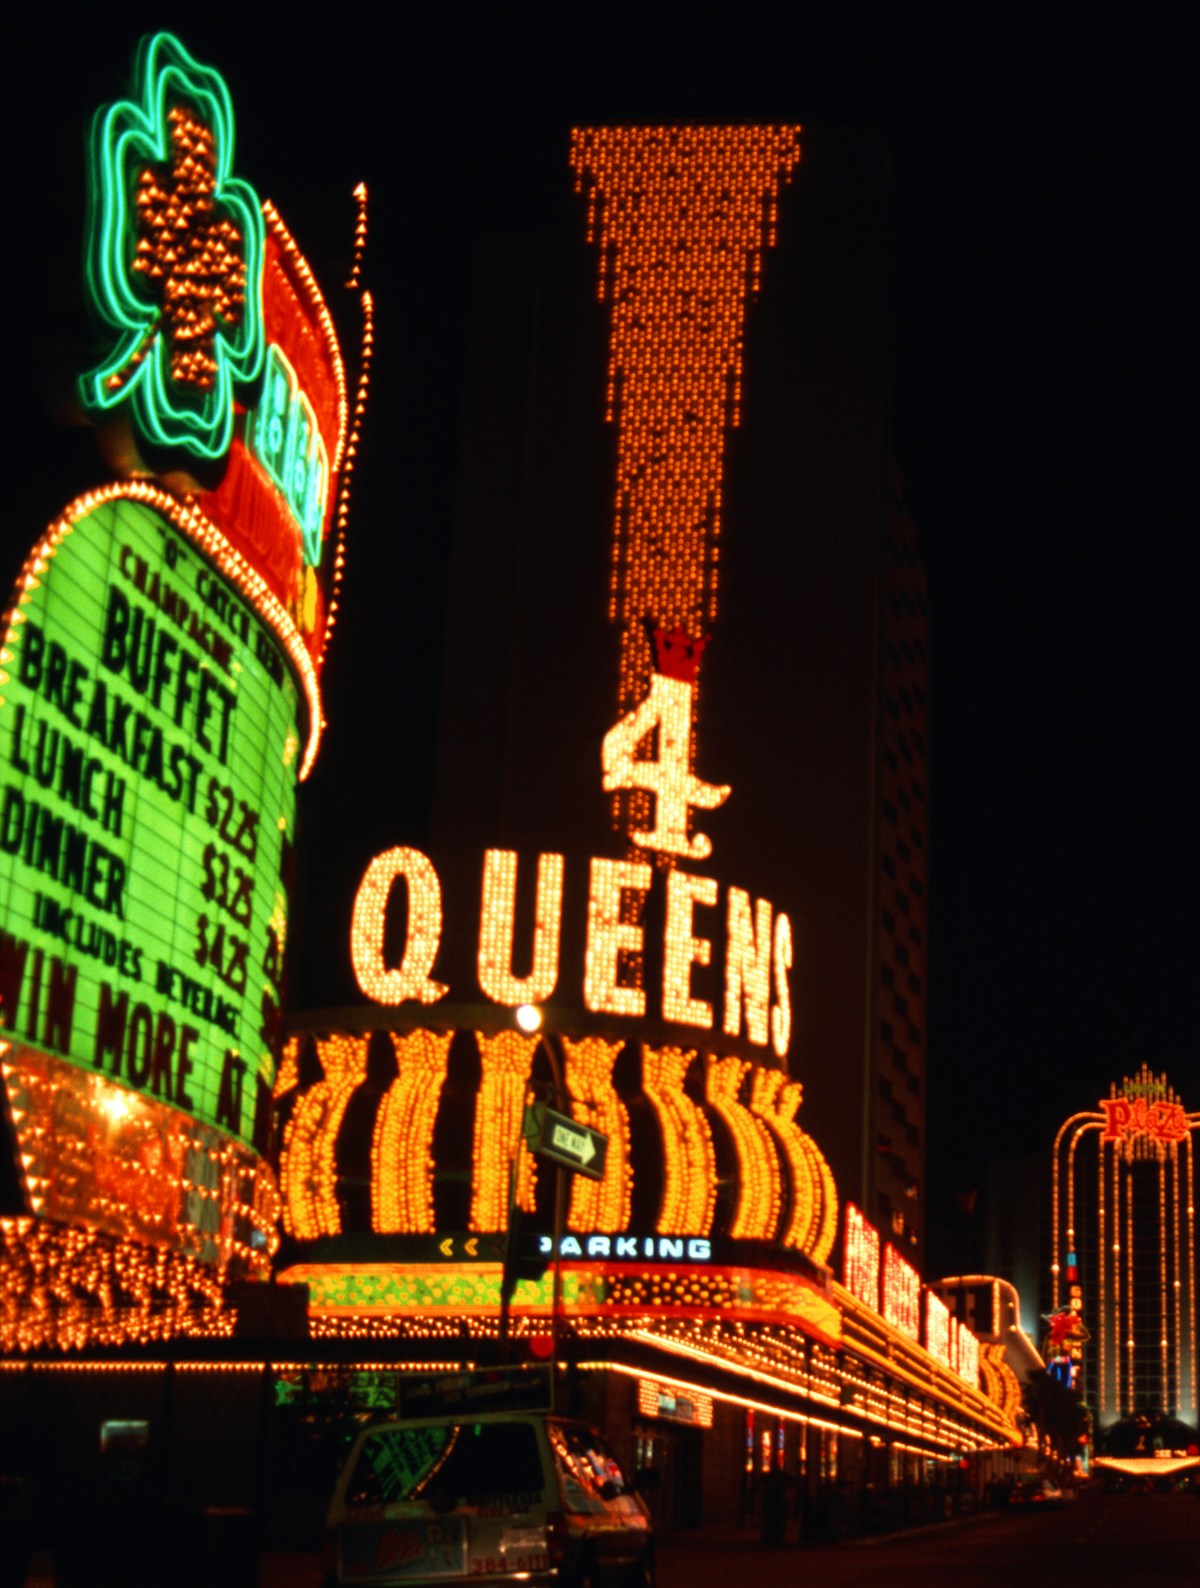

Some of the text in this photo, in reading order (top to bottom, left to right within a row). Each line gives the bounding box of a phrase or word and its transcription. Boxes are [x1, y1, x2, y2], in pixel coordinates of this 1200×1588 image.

[20, 622, 203, 815] BREAKFAST
[99, 583, 239, 767] BUFFET
[10, 704, 126, 839] LUNCH
[601, 672, 733, 860] 4
[2, 785, 127, 921] DINNER
[34, 892, 143, 983] INCLUDES
[350, 845, 793, 1057] QUEENS
[95, 981, 201, 1112] MORE
[216, 1048, 248, 1136] AT
[1099, 1097, 1193, 1141] Plaza
